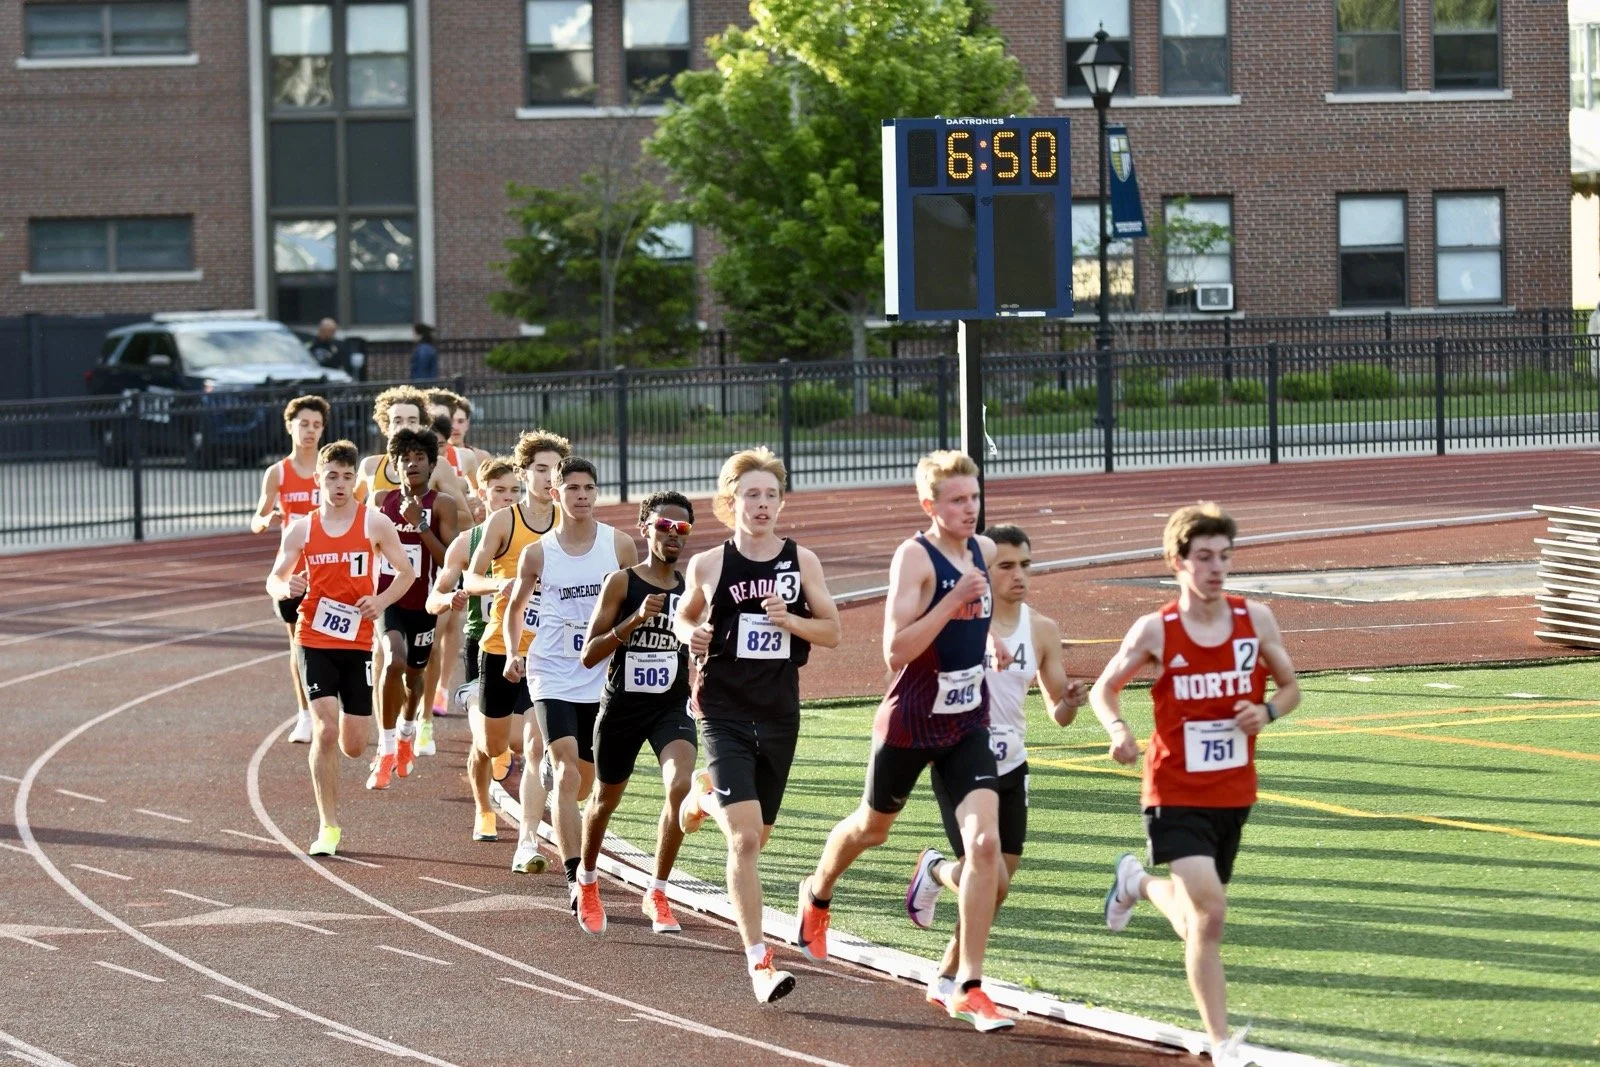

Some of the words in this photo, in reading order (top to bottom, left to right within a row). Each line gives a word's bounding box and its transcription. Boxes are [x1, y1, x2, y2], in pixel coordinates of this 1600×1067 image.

[947, 131, 1057, 179] 6:50
[354, 554, 363, 575] 1
[780, 574, 797, 602] 3
[321, 611, 352, 634] 783
[747, 630, 783, 652] 823
[1013, 643, 1027, 670] 4
[1240, 642, 1254, 671] 2
[634, 667, 670, 687] 503
[1172, 672, 1252, 700] NORTH
[1201, 738, 1235, 762] 751
